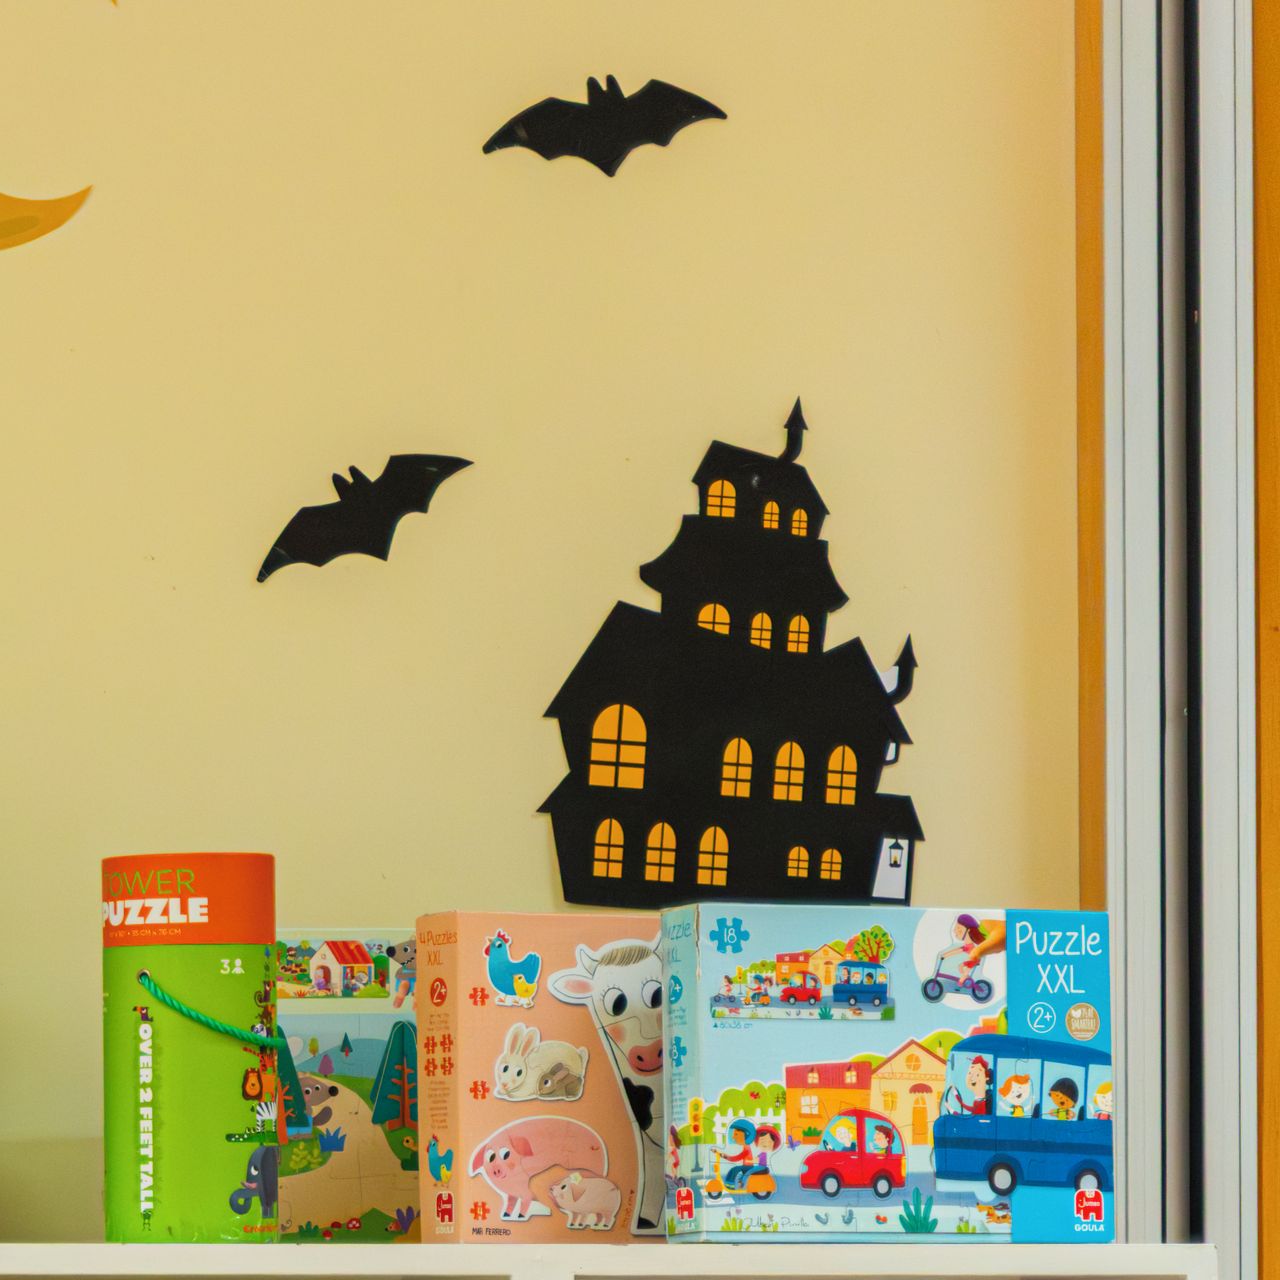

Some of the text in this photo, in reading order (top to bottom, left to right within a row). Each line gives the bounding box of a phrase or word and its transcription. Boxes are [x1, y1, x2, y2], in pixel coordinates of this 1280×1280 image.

[427, 930, 458, 946] Puzzles
[724, 927, 737, 943] 18
[1015, 921, 1102, 956] Puzzle
[220, 959, 230, 974] 3
[427, 951, 443, 966] XXL
[1036, 963, 1086, 994] XXL
[433, 981, 447, 1003] 2+
[1033, 1007, 1053, 1028] 2+
[139, 1023, 154, 1214] OVER 2 FEET TALL
[1074, 1224, 1104, 1232] GOULA
